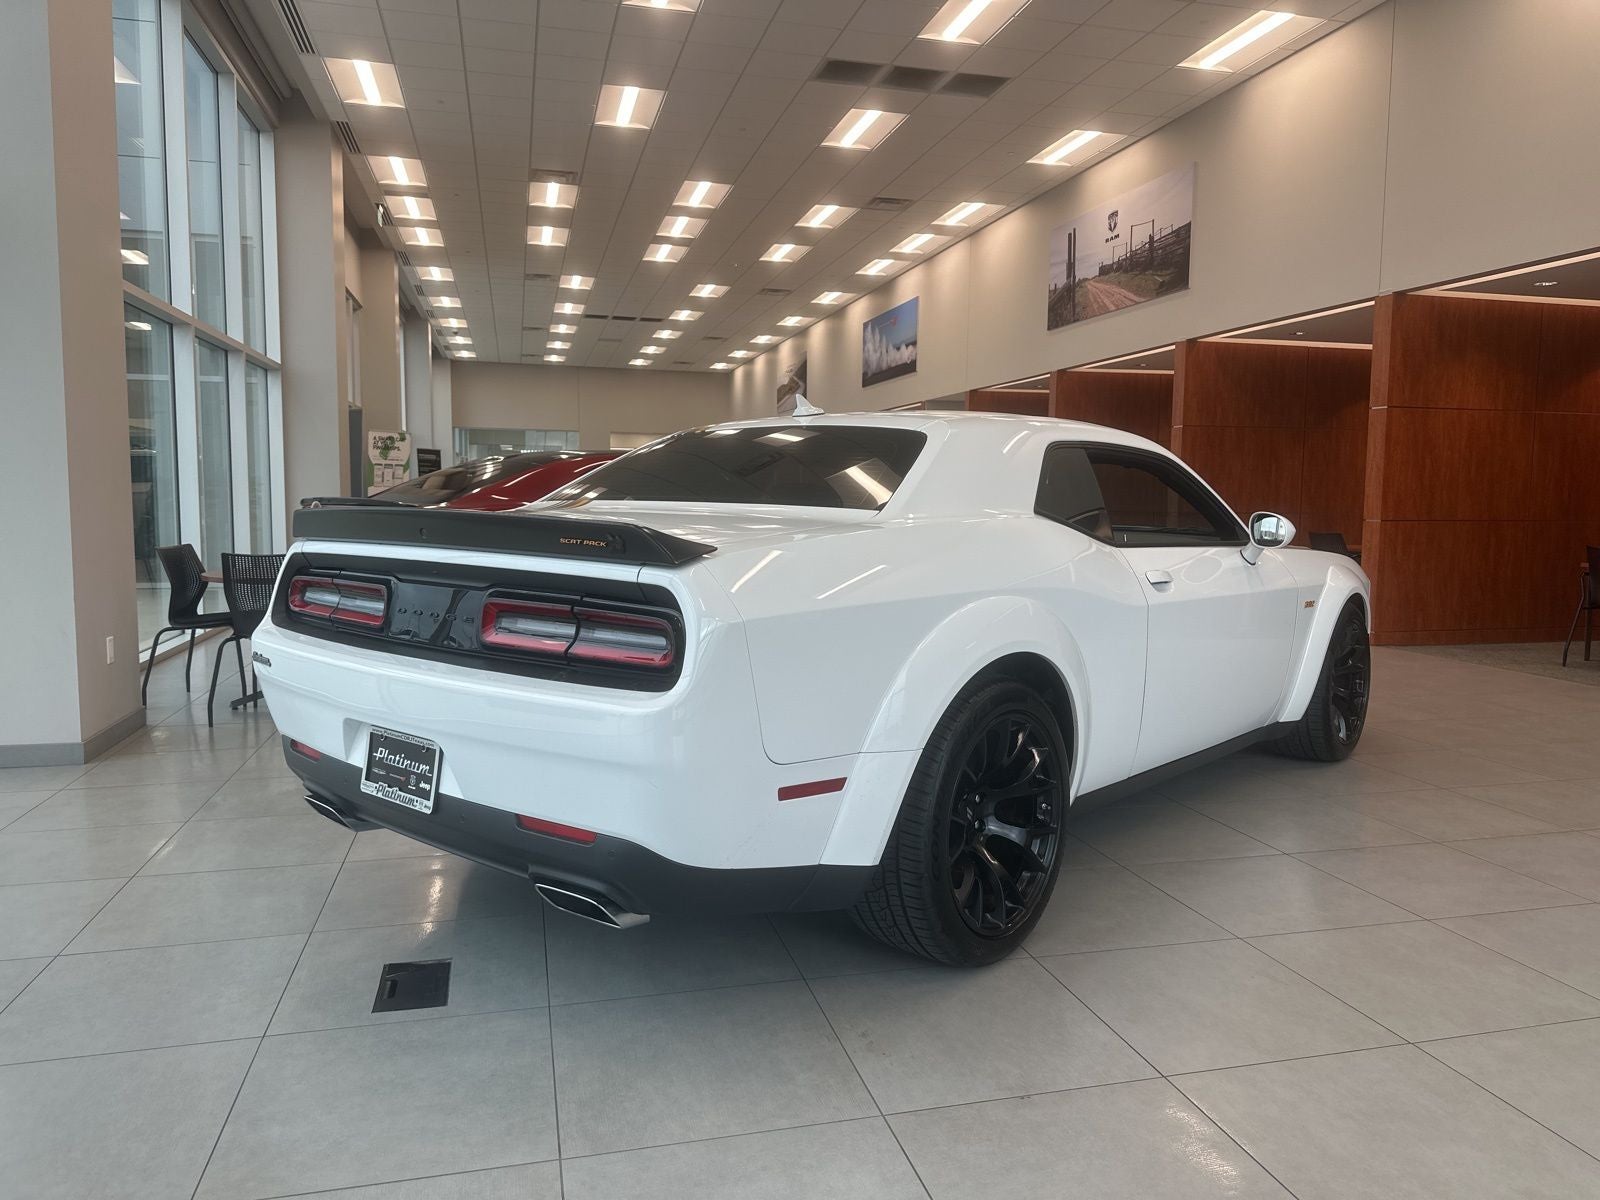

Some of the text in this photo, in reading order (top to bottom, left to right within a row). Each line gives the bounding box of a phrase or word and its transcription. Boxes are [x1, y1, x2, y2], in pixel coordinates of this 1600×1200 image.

[1105, 233, 1119, 244] RAM
[560, 537, 582, 545] SCAT
[373, 747, 432, 776] Platinum
[376, 783, 418, 807] Platinum
